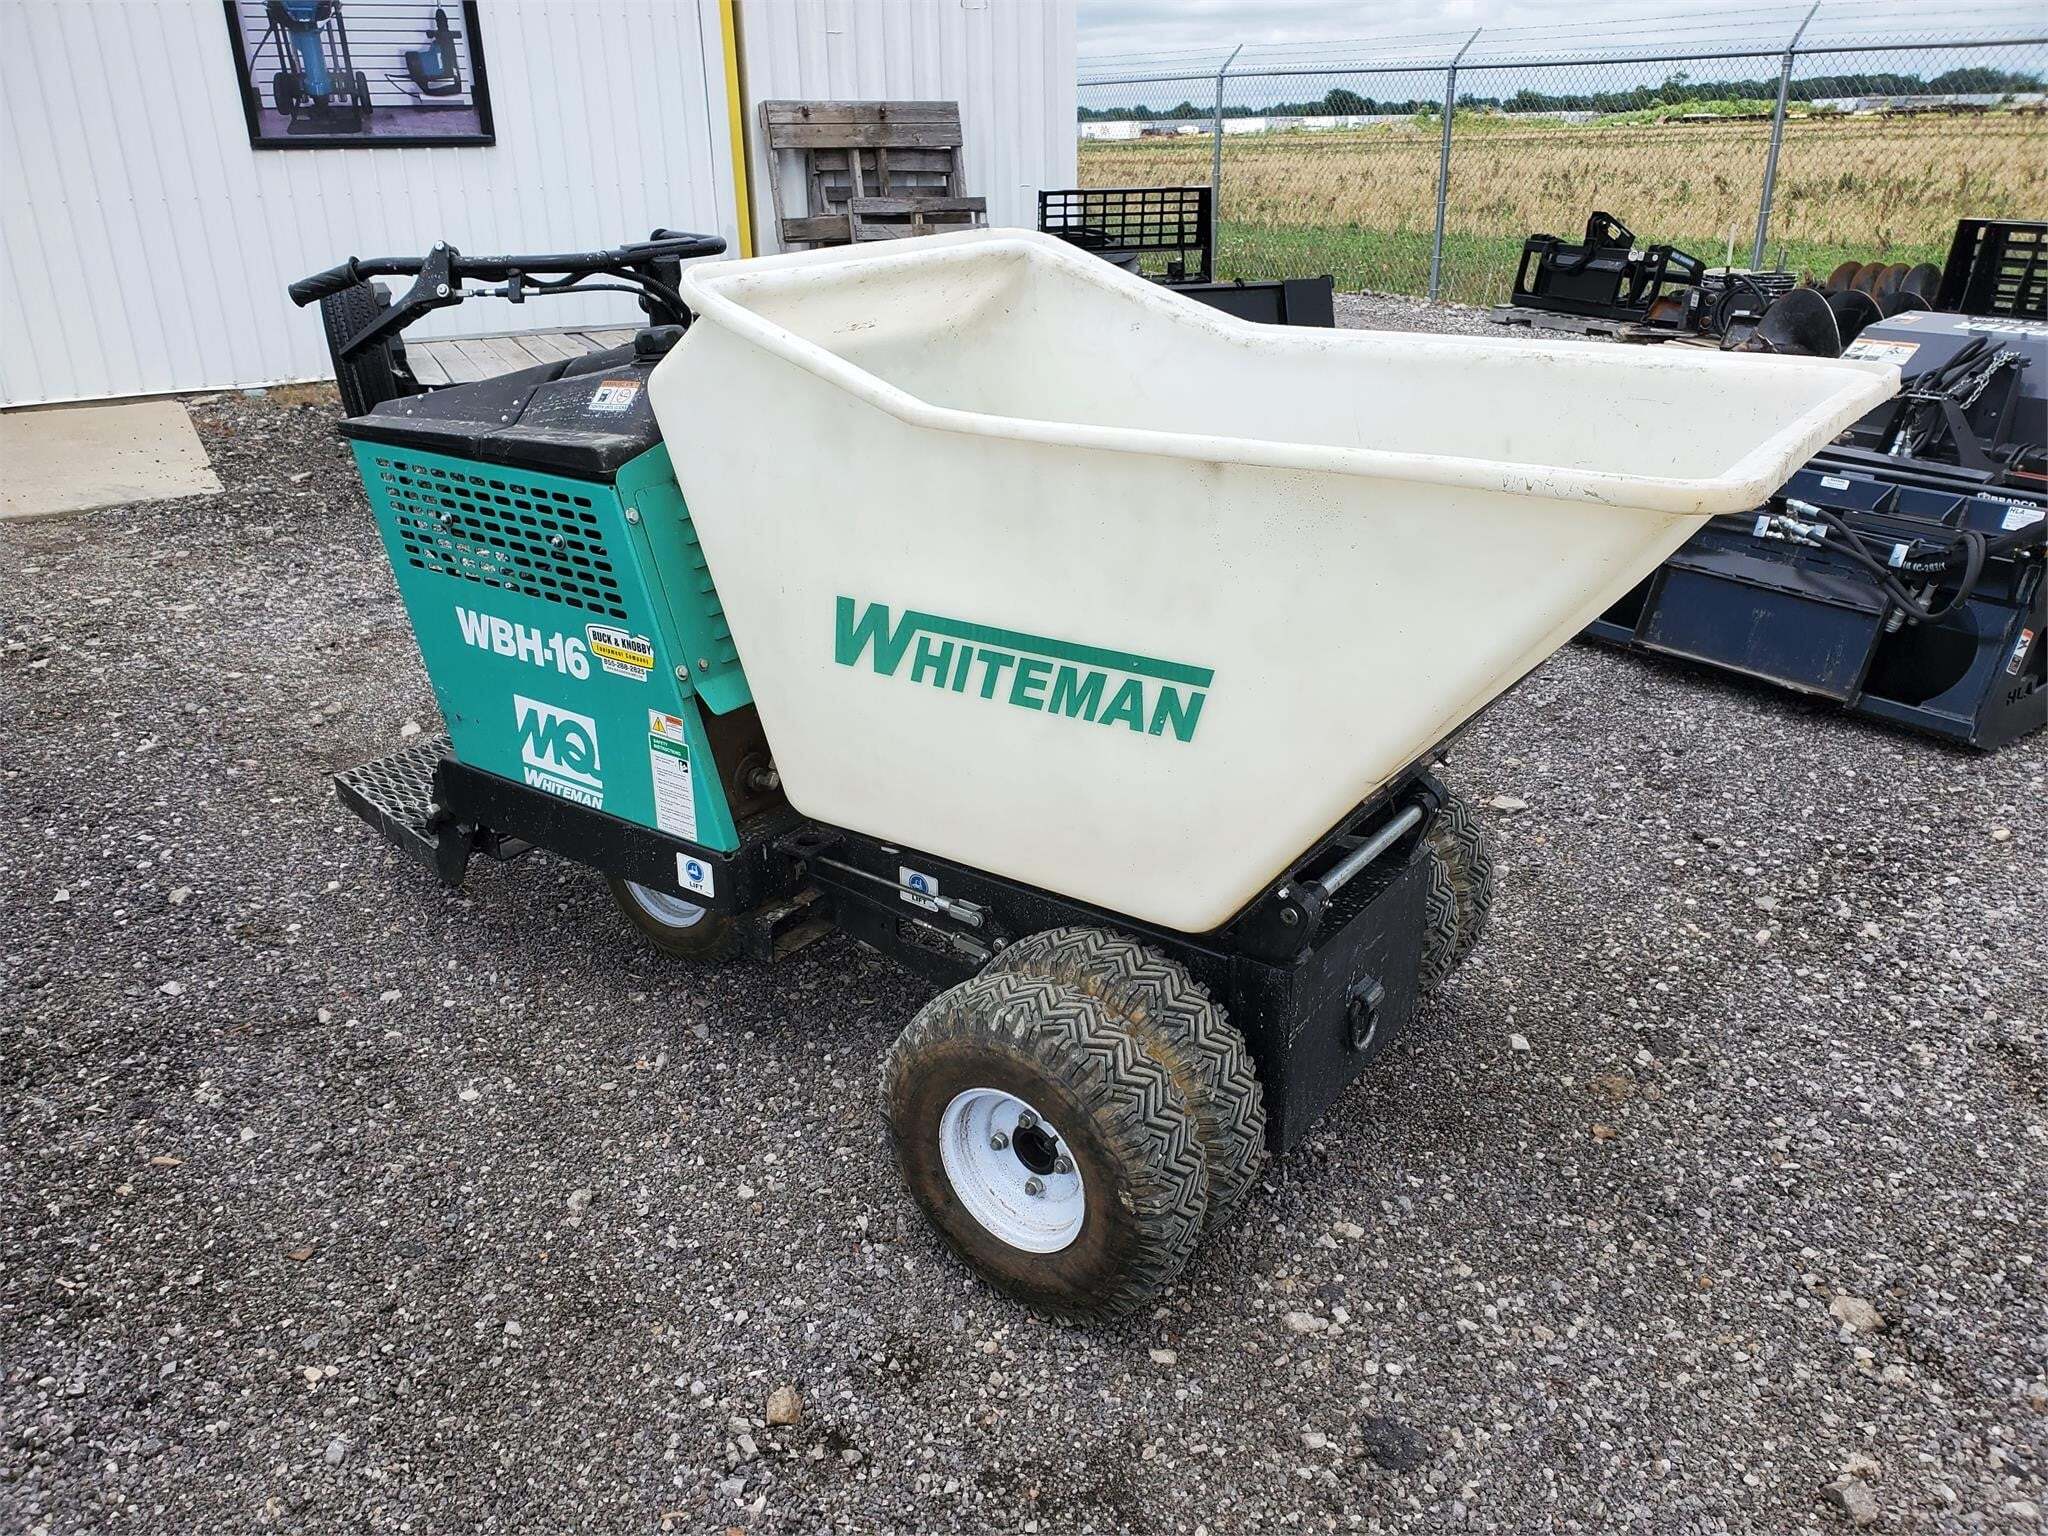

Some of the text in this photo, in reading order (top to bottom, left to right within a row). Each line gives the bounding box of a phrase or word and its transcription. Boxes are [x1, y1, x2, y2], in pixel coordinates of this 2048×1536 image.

[456, 606, 590, 680] WBH-16
[592, 630, 651, 655] BUCK & KNOBBY
[835, 595, 1215, 743] WHITEMAN
[515, 697, 603, 784] MQ
[524, 766, 604, 810] WHITEMAN
[689, 881, 703, 891] LIFT
